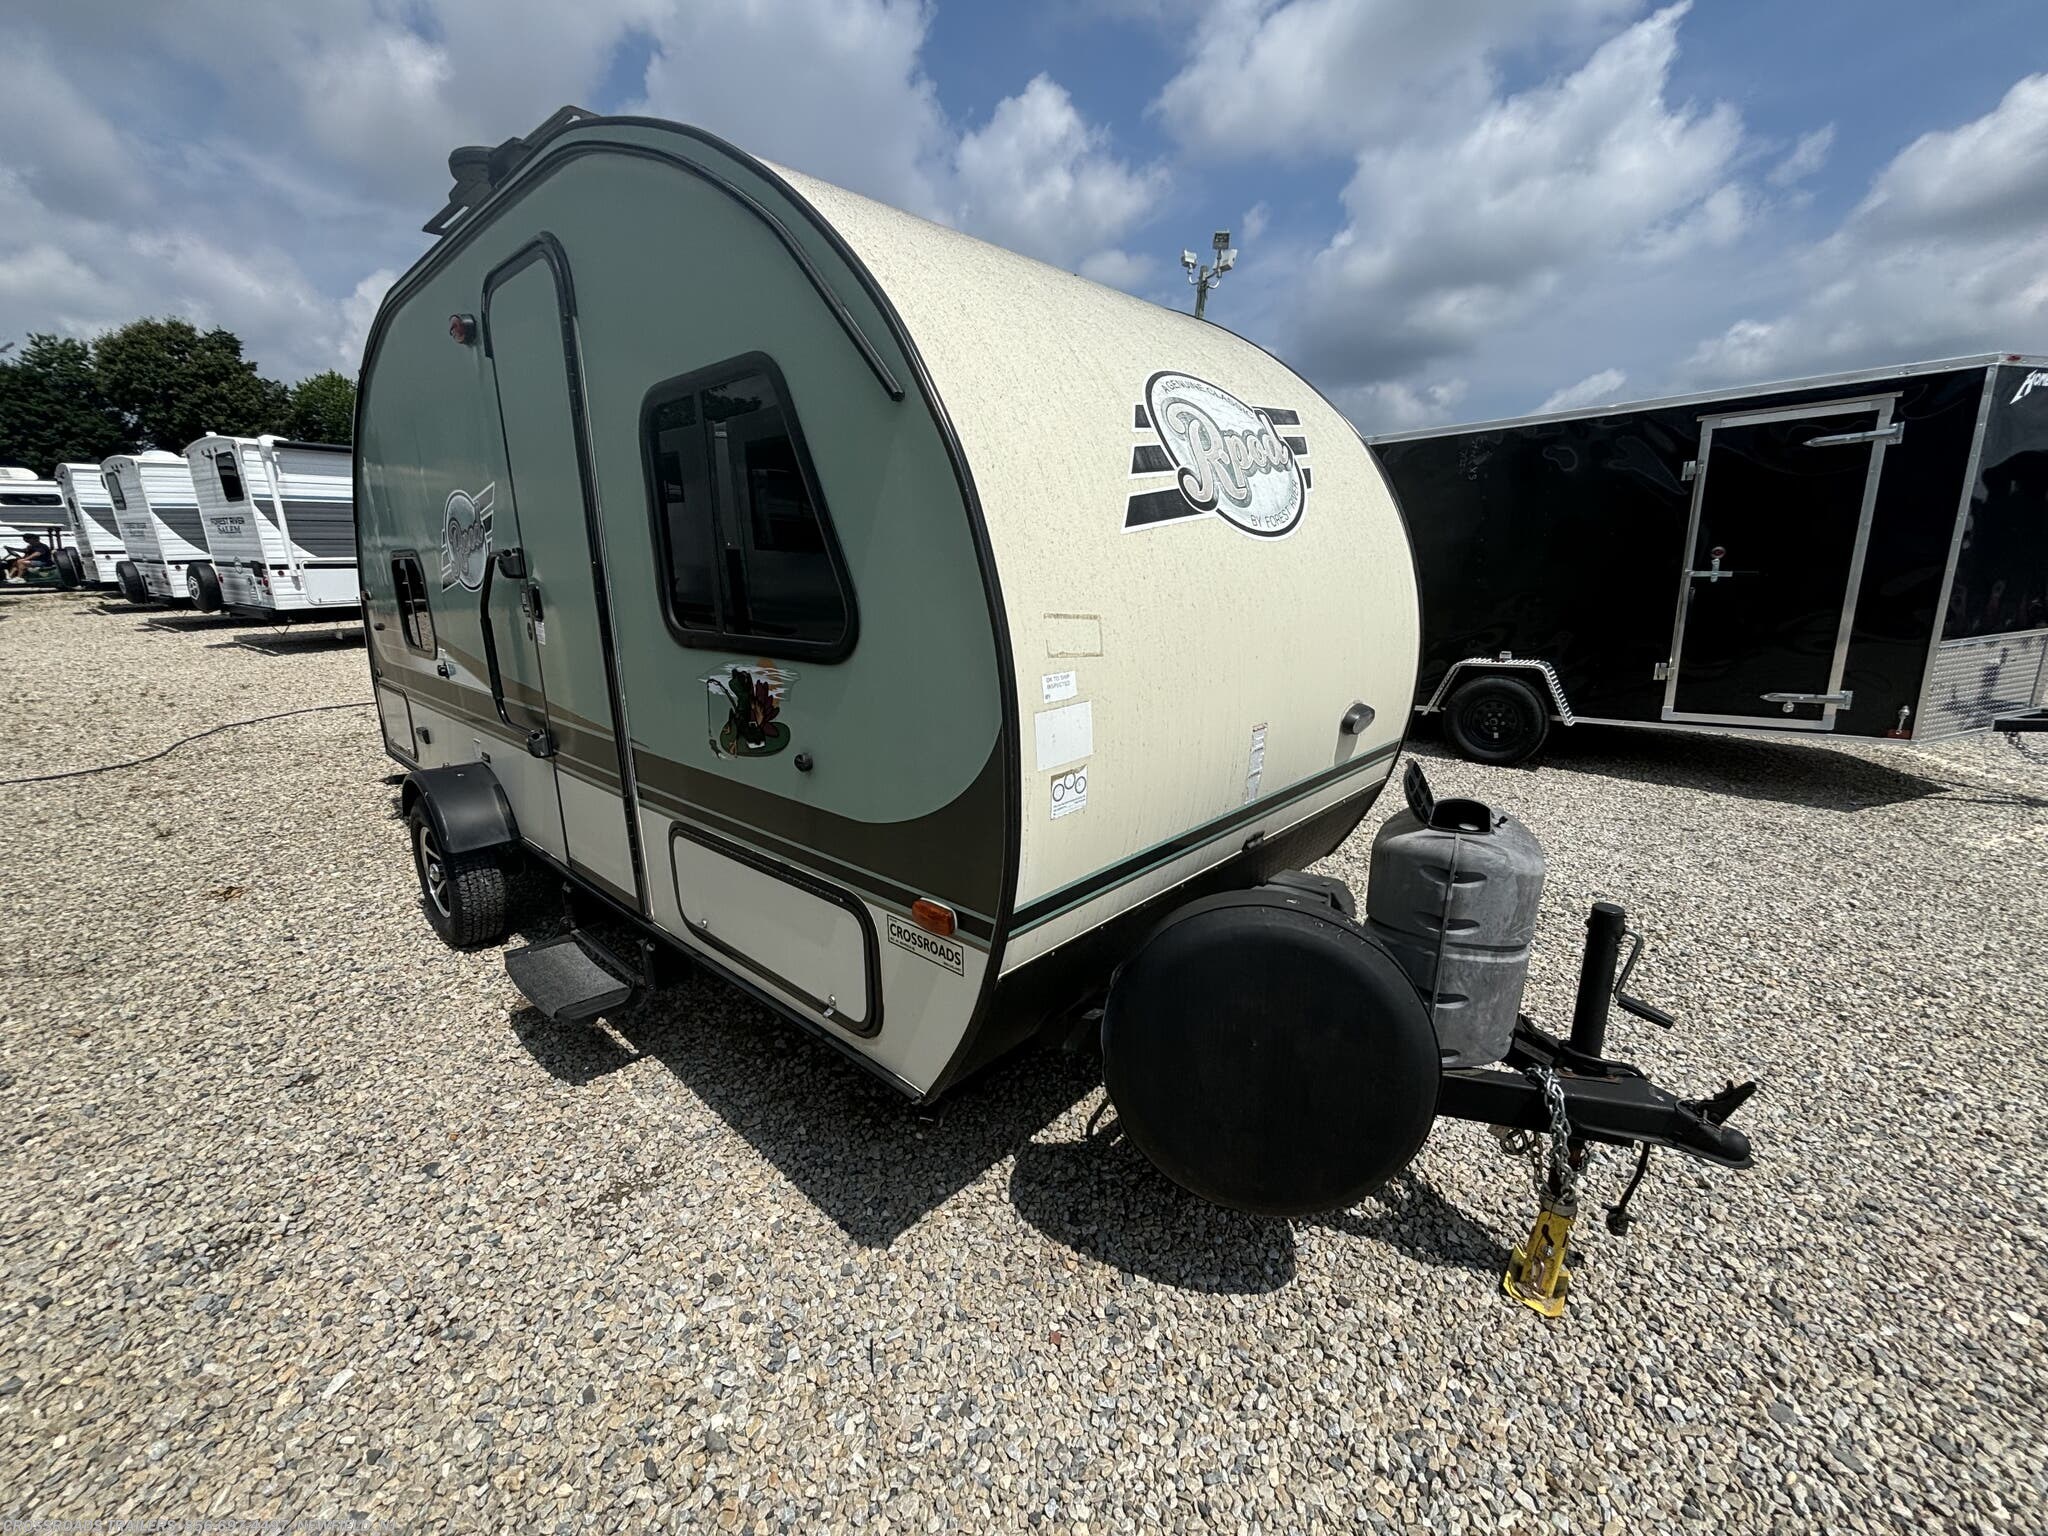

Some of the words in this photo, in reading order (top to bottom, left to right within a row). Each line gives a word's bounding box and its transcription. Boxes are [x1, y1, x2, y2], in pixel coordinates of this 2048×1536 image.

[1250, 514, 1262, 528] BY
[1265, 504, 1291, 529] FOREST
[1288, 479, 1299, 509] RIVER
[889, 923, 961, 965] CROSSROADS
